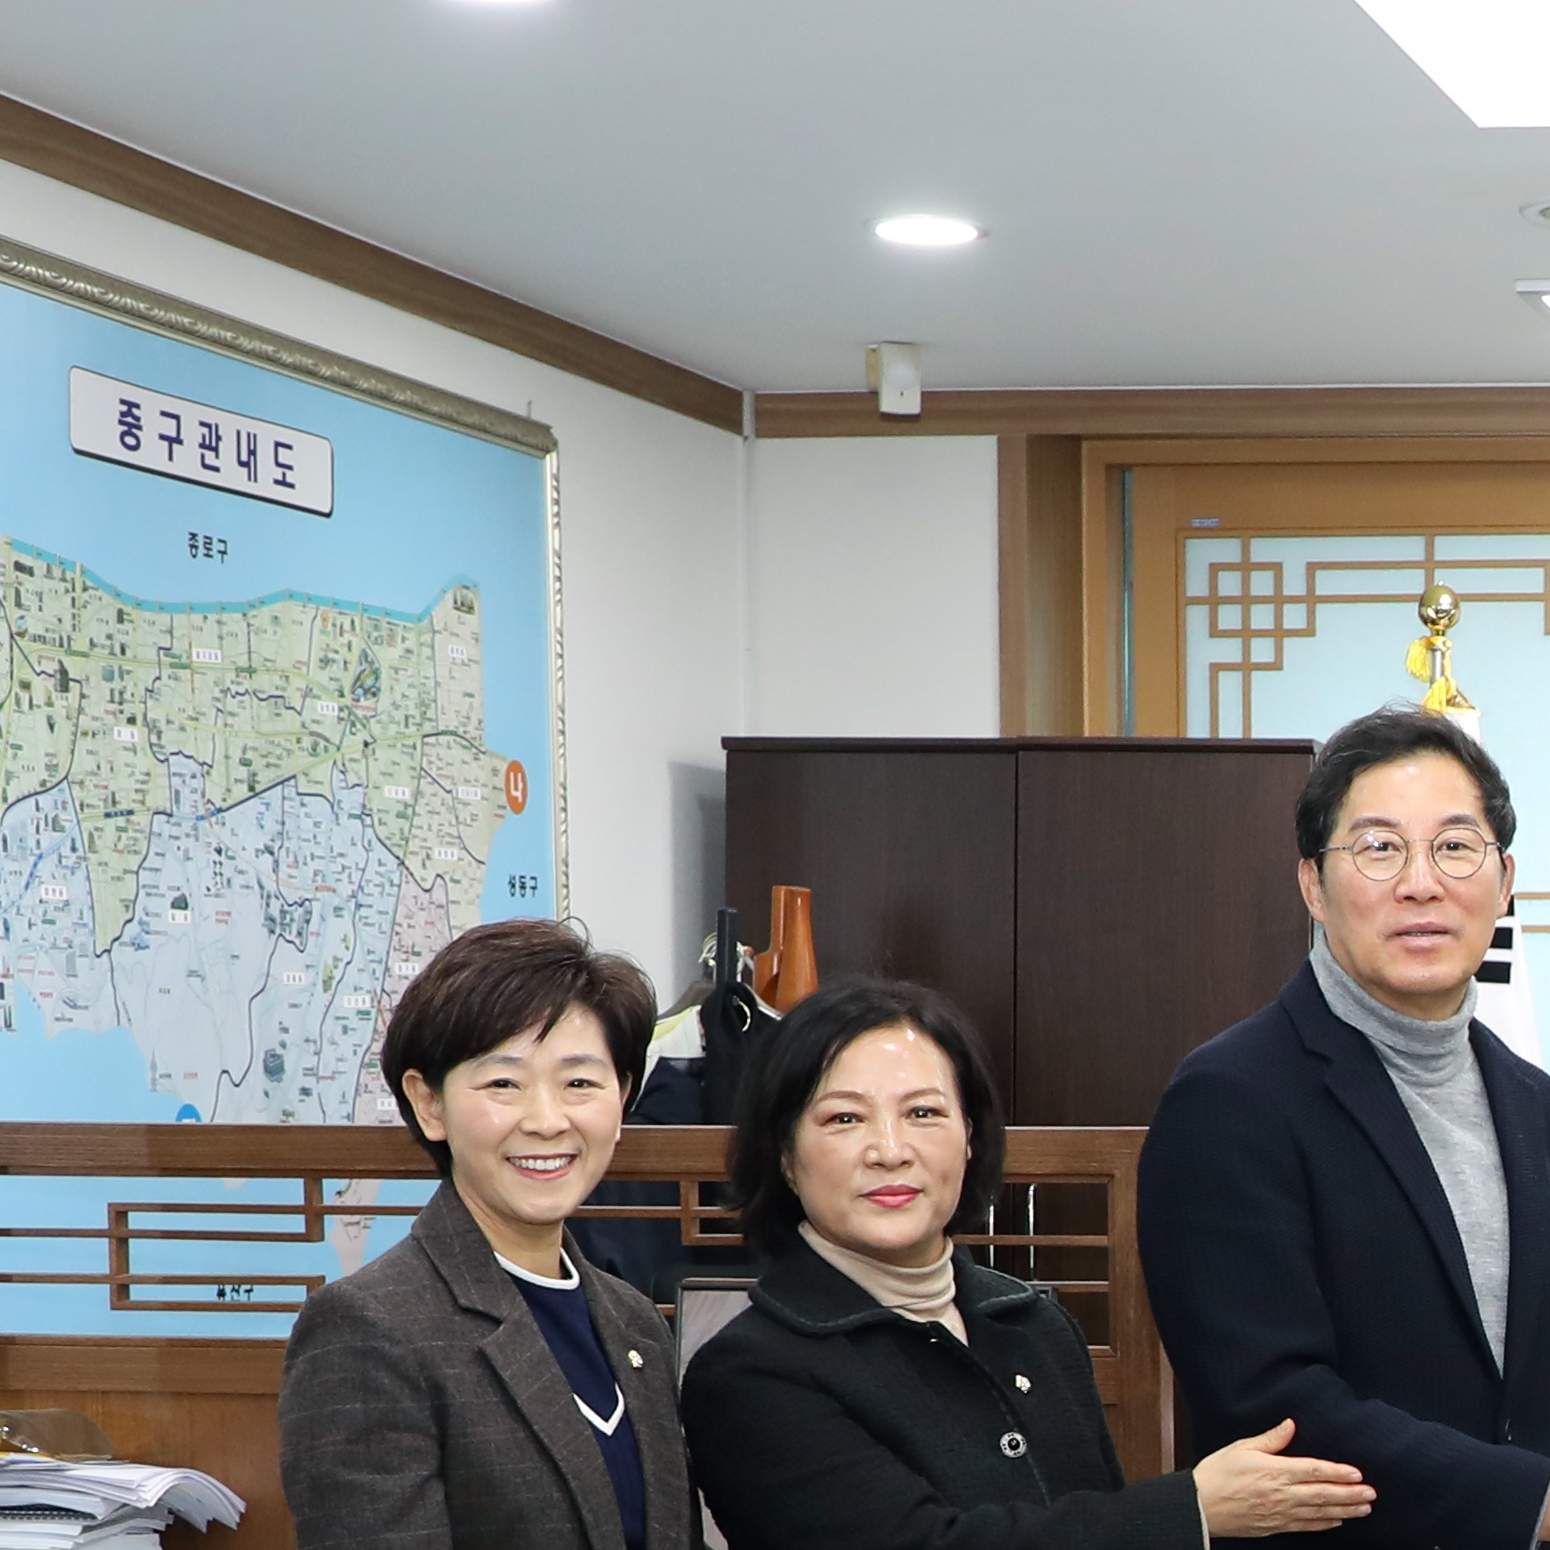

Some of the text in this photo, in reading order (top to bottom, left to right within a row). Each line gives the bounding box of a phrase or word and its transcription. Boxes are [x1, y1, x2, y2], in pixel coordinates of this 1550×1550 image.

[117, 398, 296, 490] 중구관내도
[188, 531, 228, 564] 종로구
[507, 874, 539, 898] 성동구
